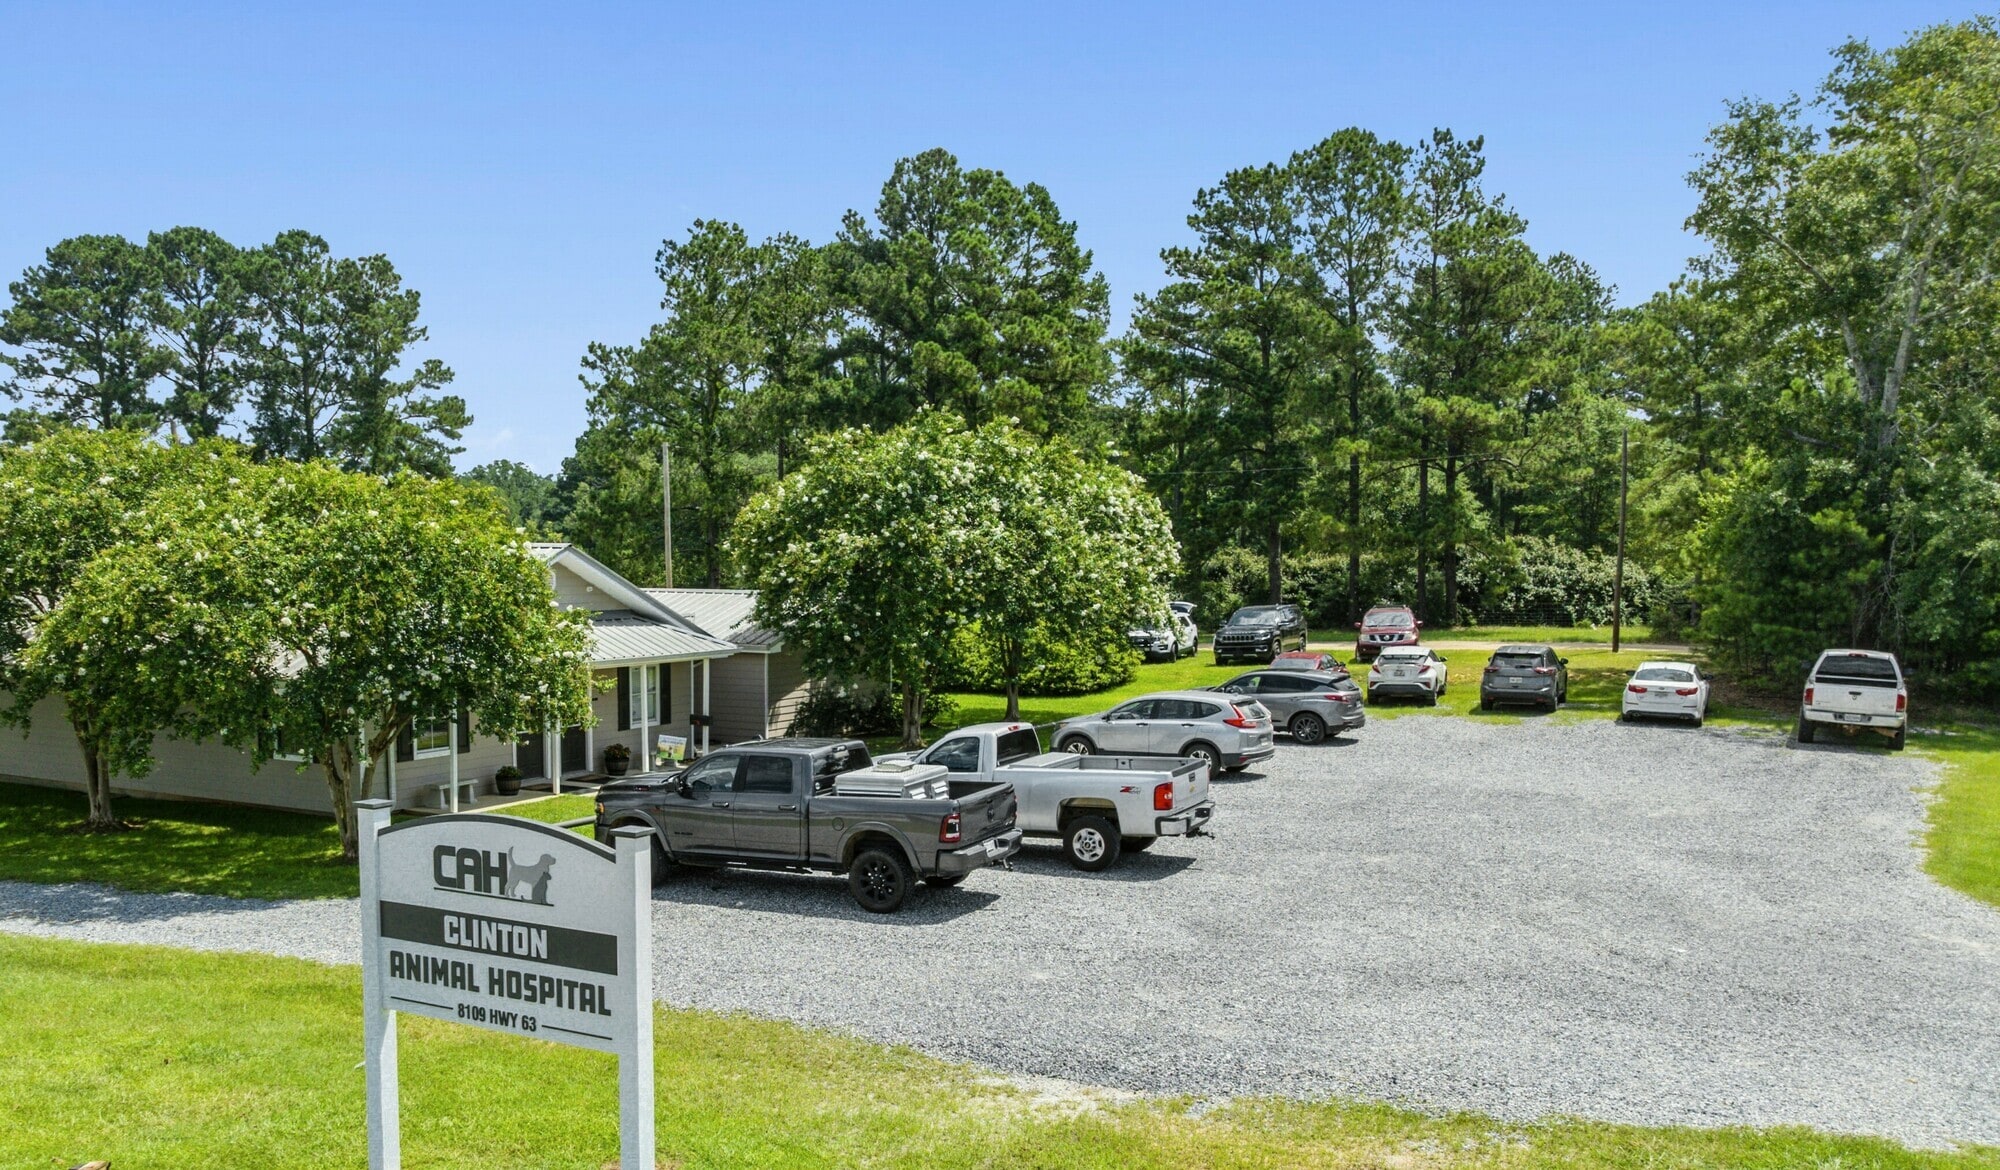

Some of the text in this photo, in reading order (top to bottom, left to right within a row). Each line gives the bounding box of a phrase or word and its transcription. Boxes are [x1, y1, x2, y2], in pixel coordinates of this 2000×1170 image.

[433, 844, 507, 895] CAH
[443, 915, 548, 960] CLINTON
[390, 950, 612, 1017] ANIMAL HOSPITAL
[457, 1003, 537, 1032] 8109 HWY 63
